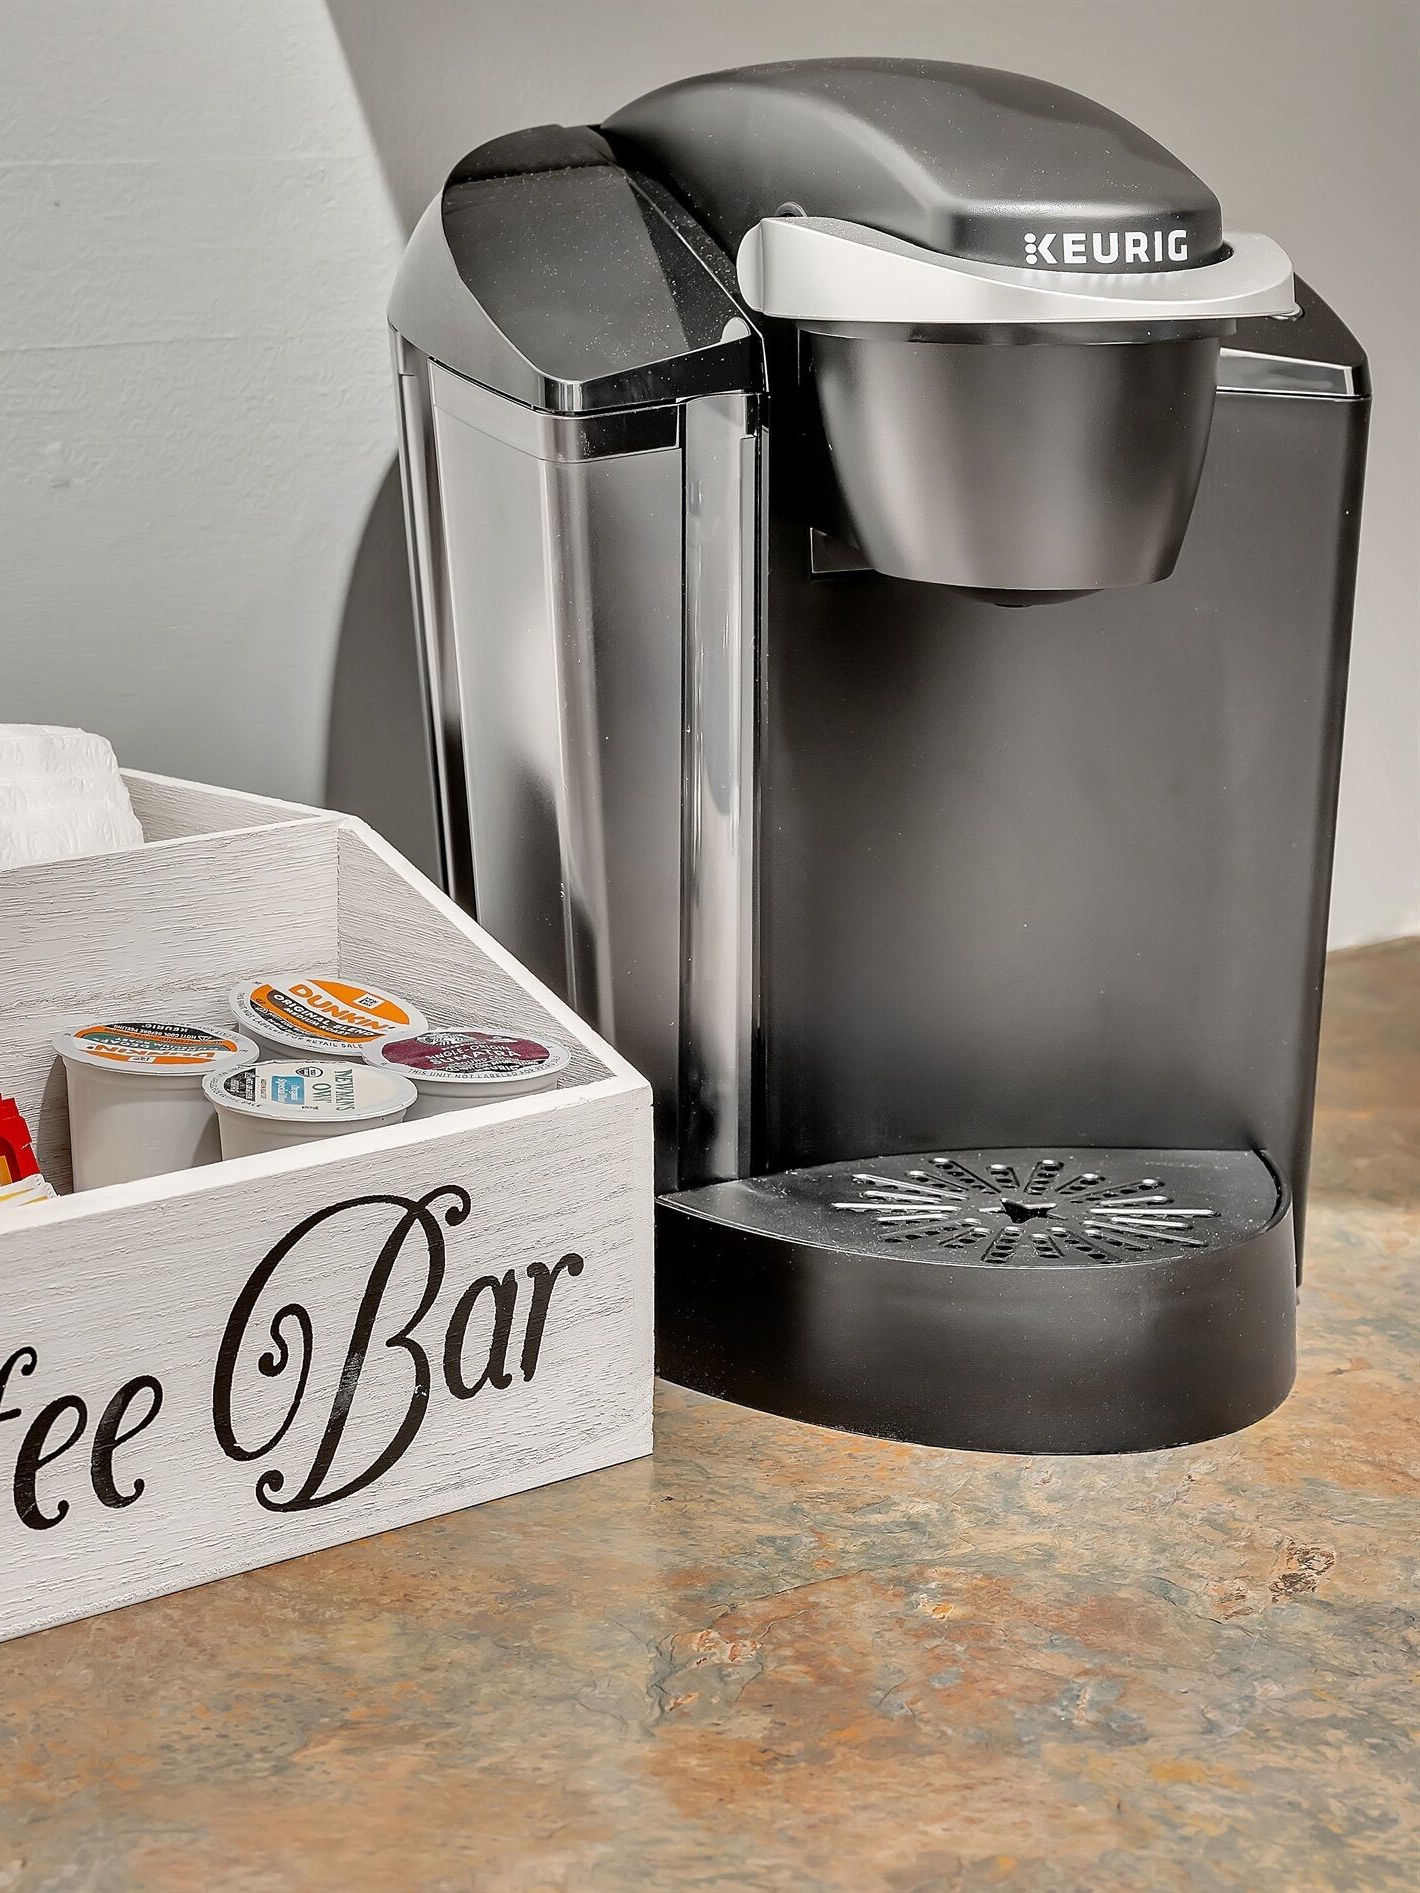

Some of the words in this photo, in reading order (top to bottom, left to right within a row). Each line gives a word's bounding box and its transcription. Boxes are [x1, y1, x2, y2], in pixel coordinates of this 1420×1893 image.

[1024, 229, 1188, 265] KEURIG
[273, 994, 330, 1027] ORIGINAL
[333, 1024, 375, 1036] BLEND
[283, 1007, 320, 1027] MEDIUM
[320, 1025, 351, 1036] ROAST
[113, 1024, 139, 1033] PEELING
[143, 1023, 189, 1033] KEURIG
[180, 1032, 197, 1040] HOT!
[306, 1039, 338, 1048] RETAIL
[429, 1048, 521, 1065] SUMATRA
[408, 1068, 426, 1076] THIS
[477, 1069, 518, 1079] LABELED
[212, 1184, 584, 1513] Bar
